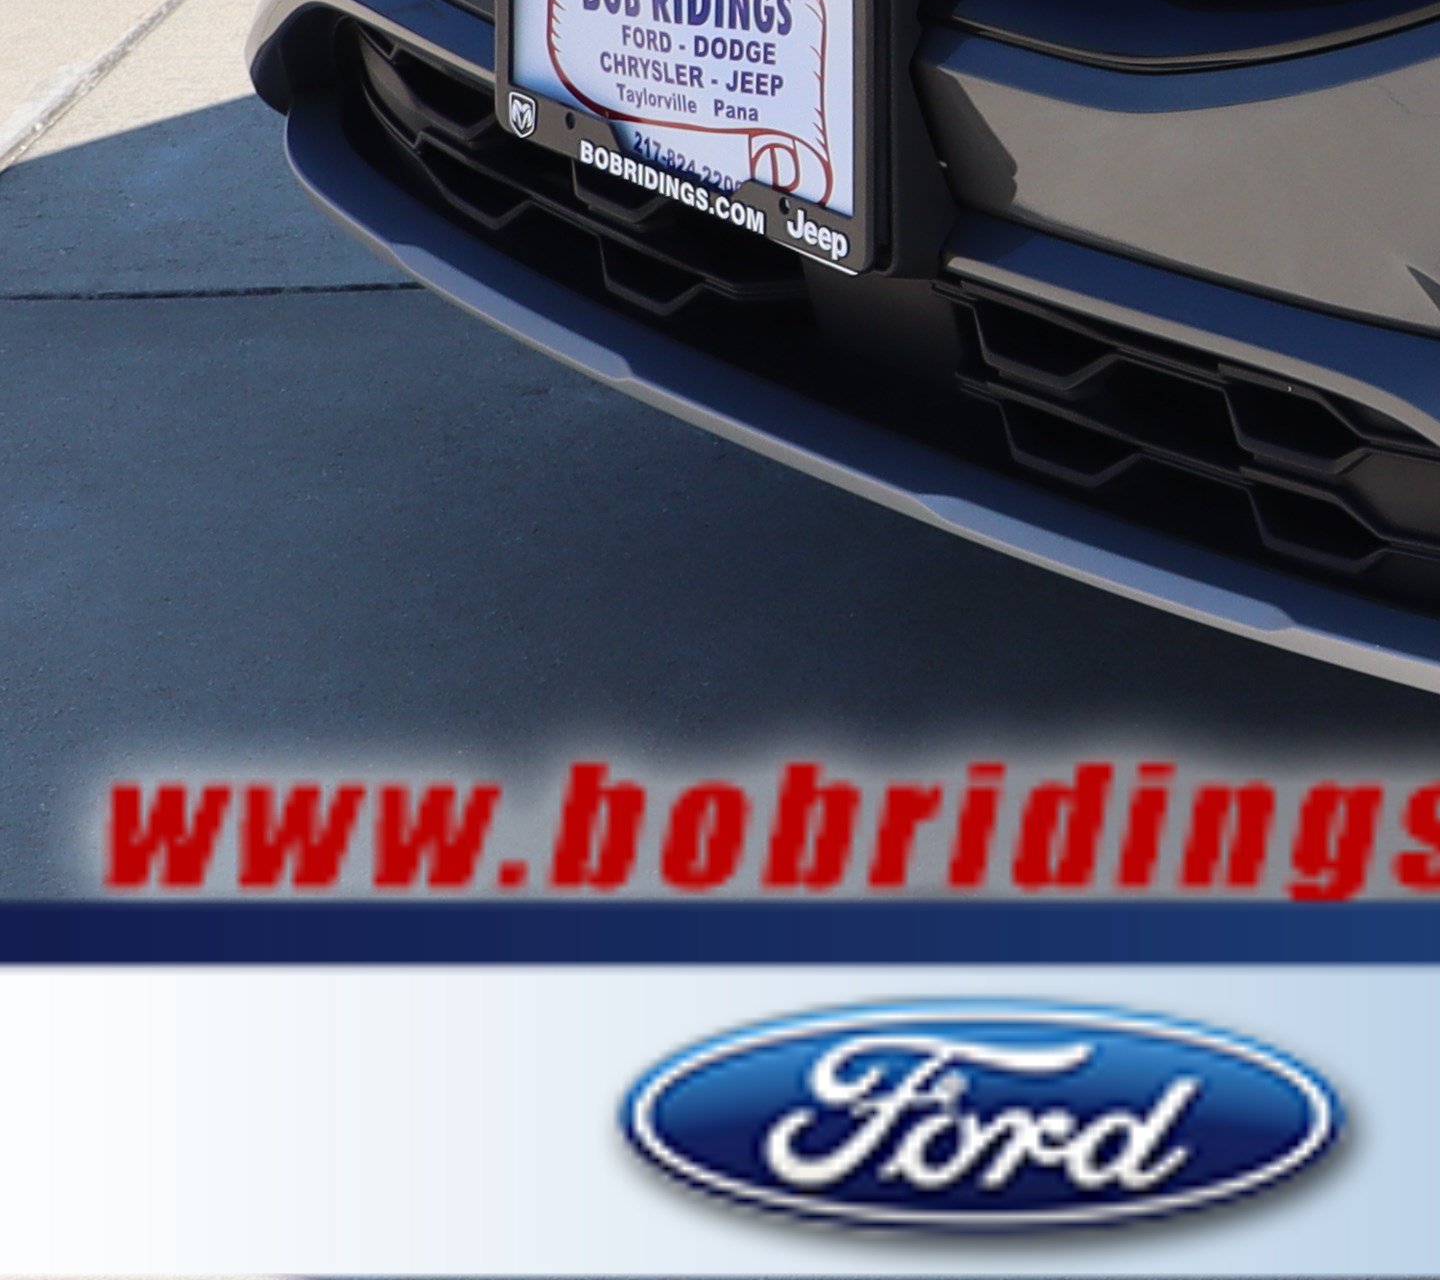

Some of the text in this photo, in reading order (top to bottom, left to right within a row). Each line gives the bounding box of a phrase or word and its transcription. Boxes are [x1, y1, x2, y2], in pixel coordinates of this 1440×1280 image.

[621, 24, 672, 54] FORD
[694, 35, 777, 66] DODGE
[600, 51, 704, 89] CHRYSLER
[726, 70, 785, 97] JEEP
[616, 83, 760, 123] Taylorville Pana
[580, 139, 766, 236] BOBRIDINGS.COM
[787, 209, 849, 262] Jeep
